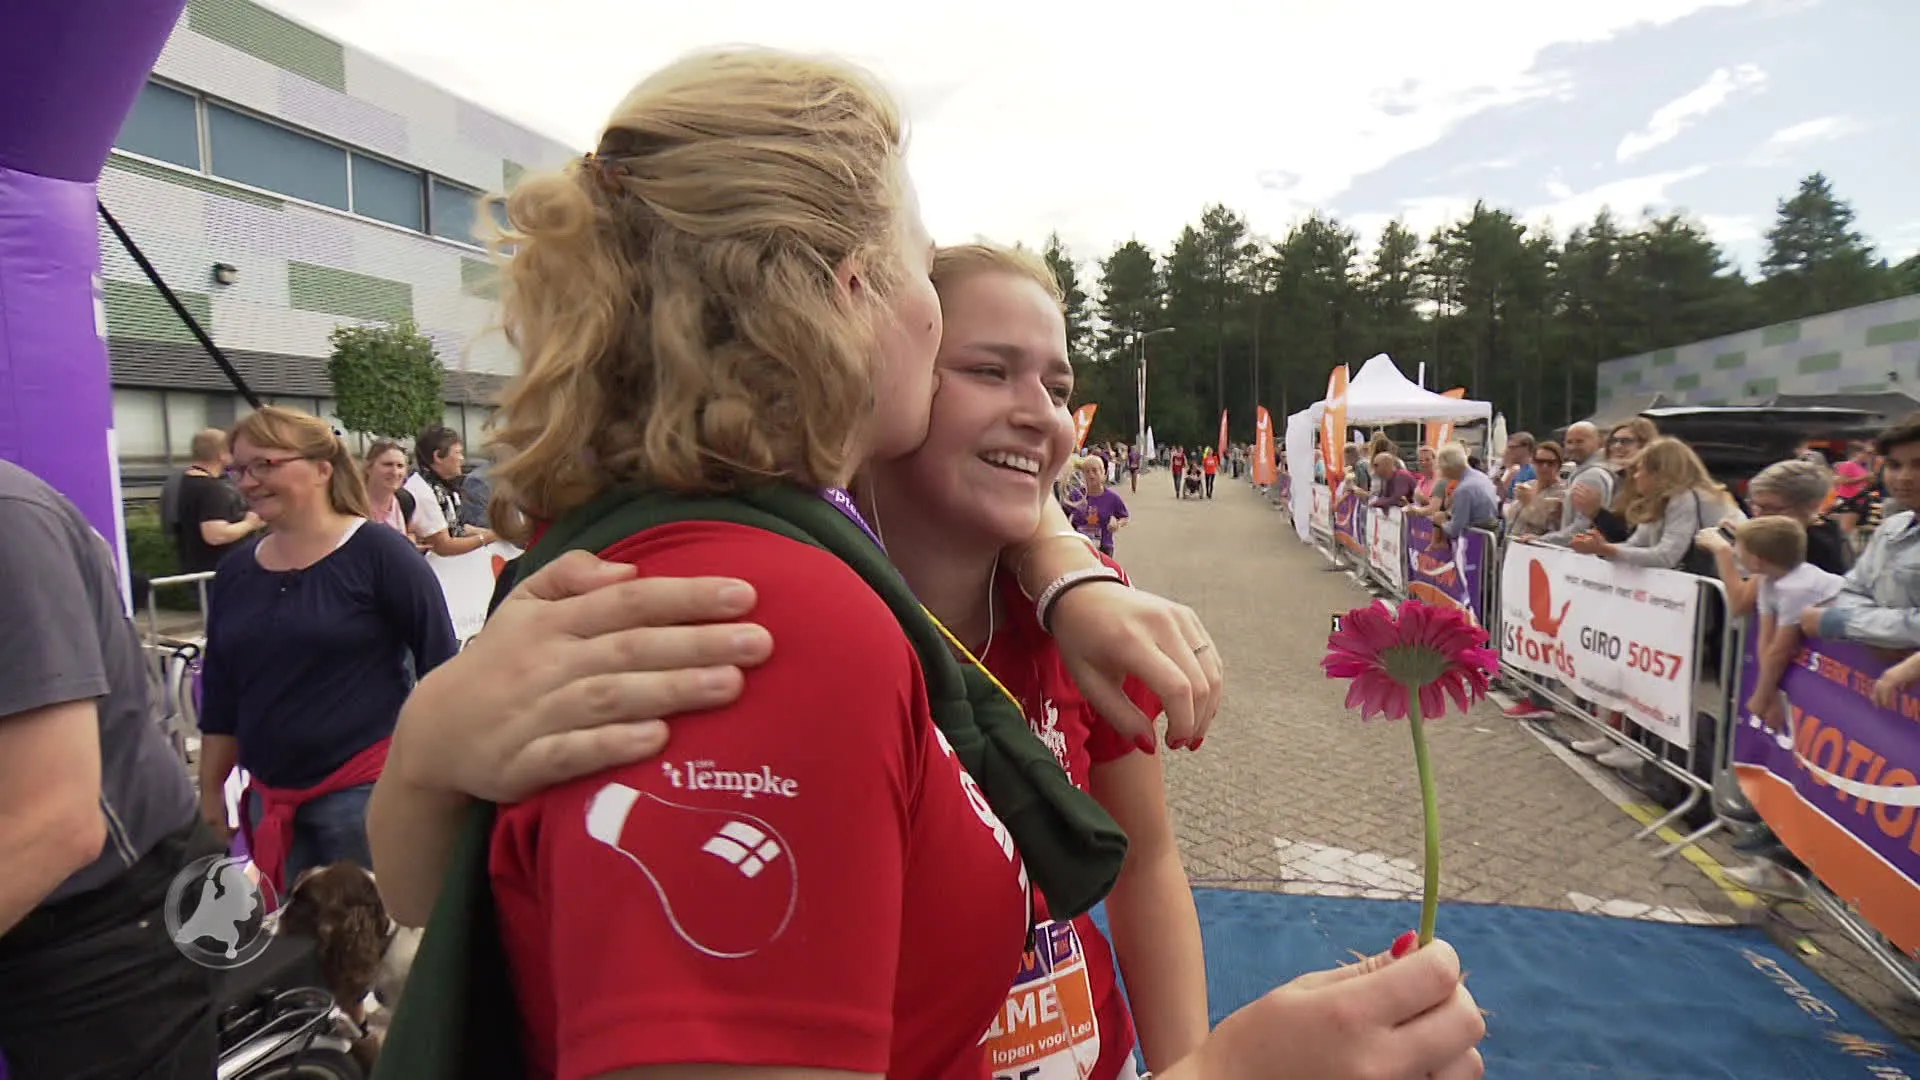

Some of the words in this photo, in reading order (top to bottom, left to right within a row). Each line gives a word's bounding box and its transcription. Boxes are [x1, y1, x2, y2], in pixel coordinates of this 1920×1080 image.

[1580, 625, 1621, 660] GIRO
[1626, 631, 1683, 681] 5057
[684, 761, 799, 798] lempke
[992, 1040, 1035, 1065] lopen
[1038, 1032, 1067, 1048] voor
[1071, 1020, 1092, 1038] Leo
